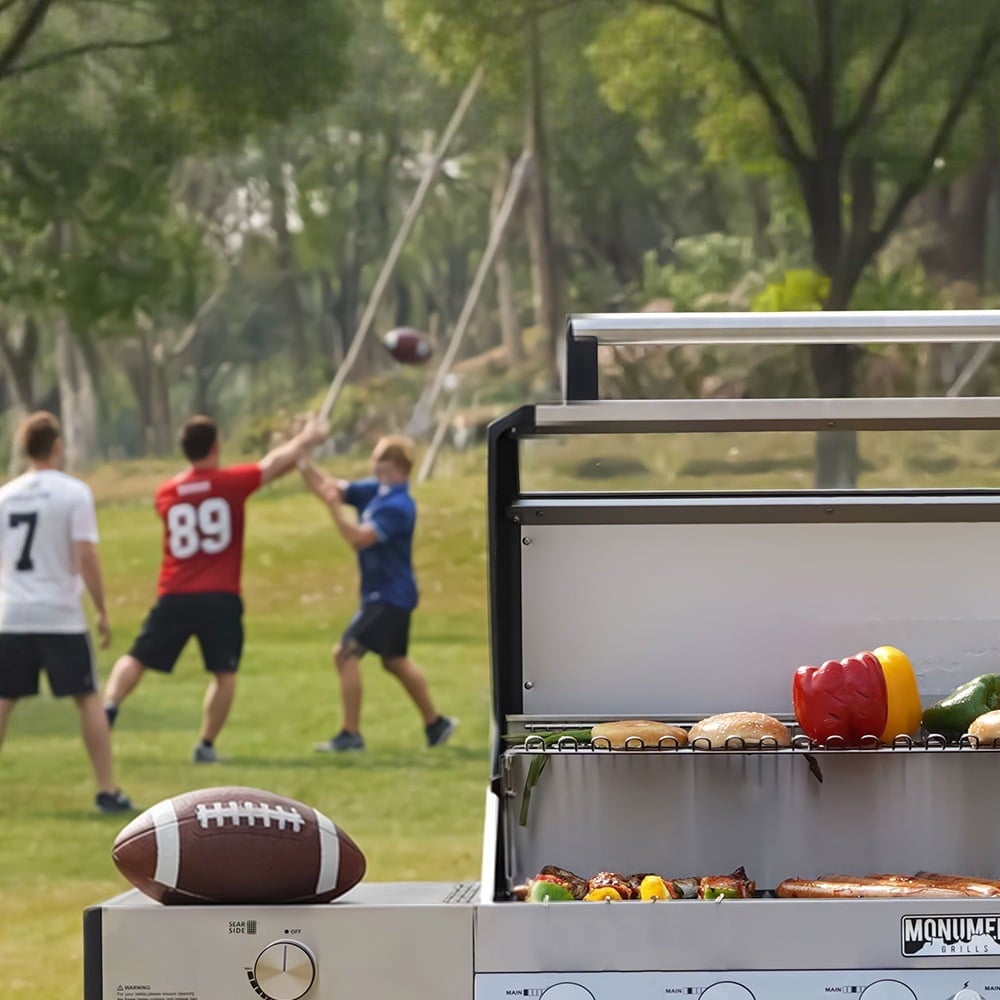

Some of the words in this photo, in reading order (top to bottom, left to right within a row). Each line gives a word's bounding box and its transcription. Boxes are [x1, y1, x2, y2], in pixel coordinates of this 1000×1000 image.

[9, 511, 38, 571] 7
[168, 497, 232, 560] 89
[941, 945, 989, 953] GRILLS
